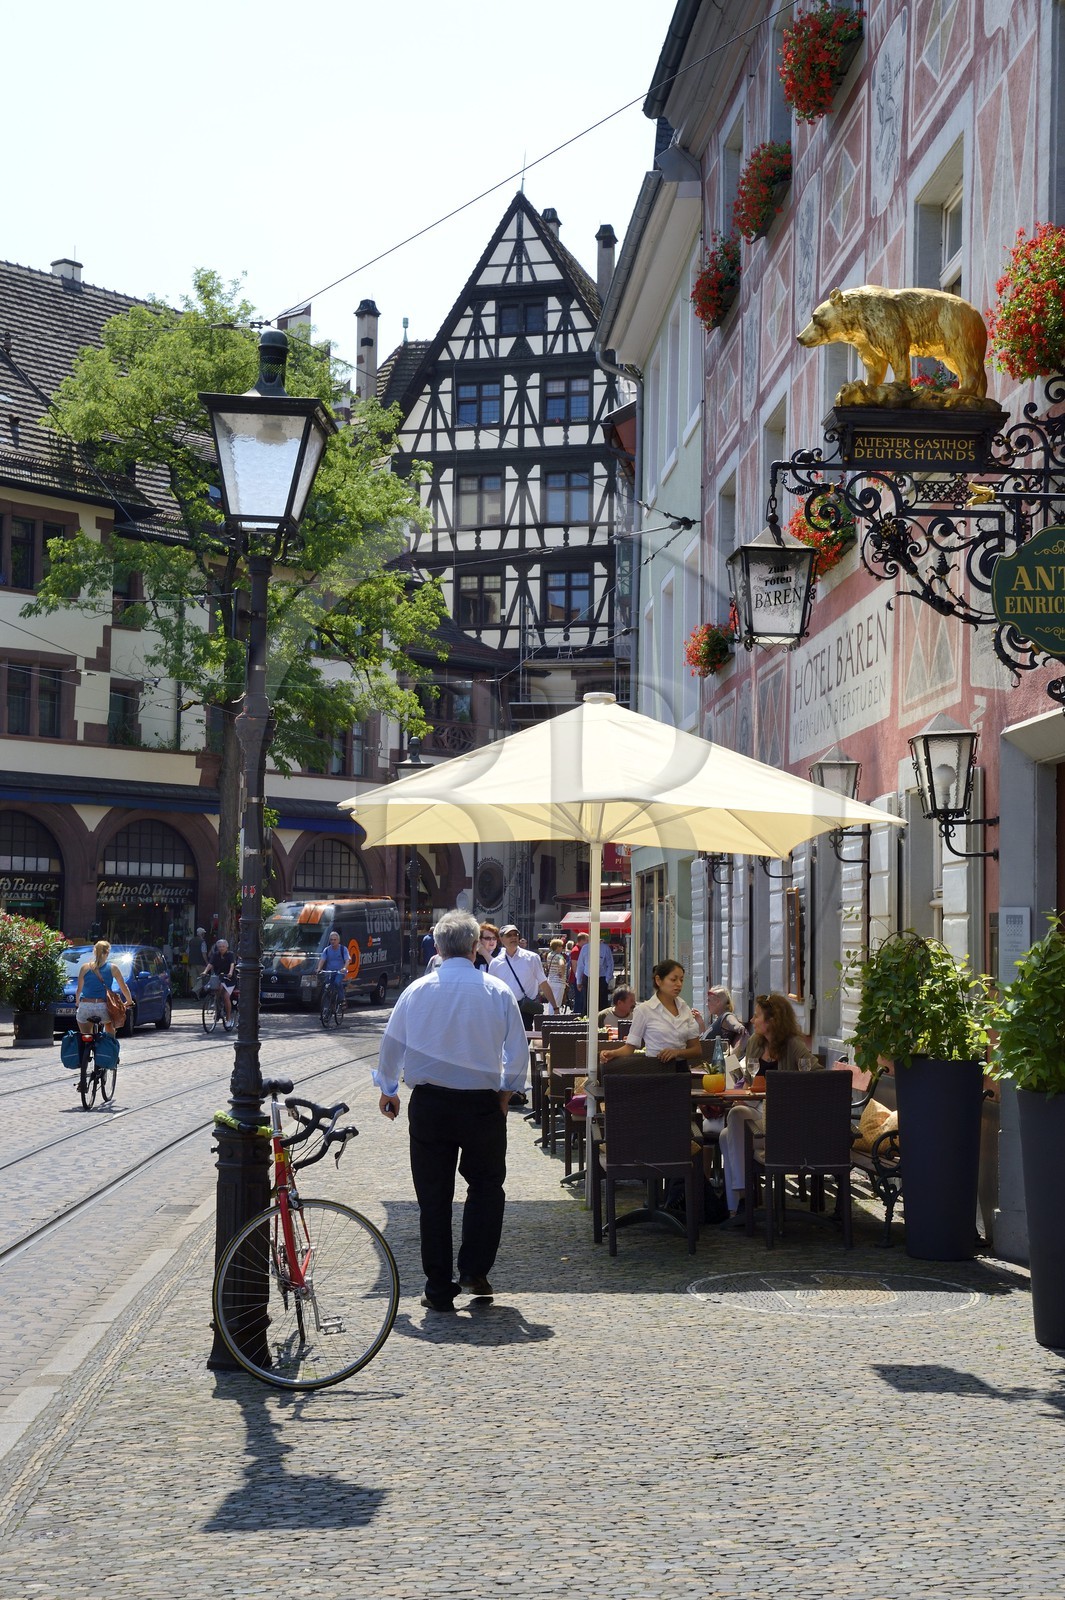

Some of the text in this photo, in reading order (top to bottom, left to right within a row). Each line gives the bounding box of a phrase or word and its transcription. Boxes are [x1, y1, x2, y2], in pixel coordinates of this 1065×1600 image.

[855, 437, 976, 450] ÄLTESTER GASTHOF
[854, 447, 976, 461] DEUTSCHLANDS
[768, 565, 789, 574] zum
[765, 576, 792, 586] roten
[755, 586, 803, 609] BÄREN
[1004, 596, 1065, 614] EINRIC
[793, 608, 888, 713] HOTEL BÄREN
[12, 877, 60, 892] Bauer
[152, 884, 193, 896] Bauer
